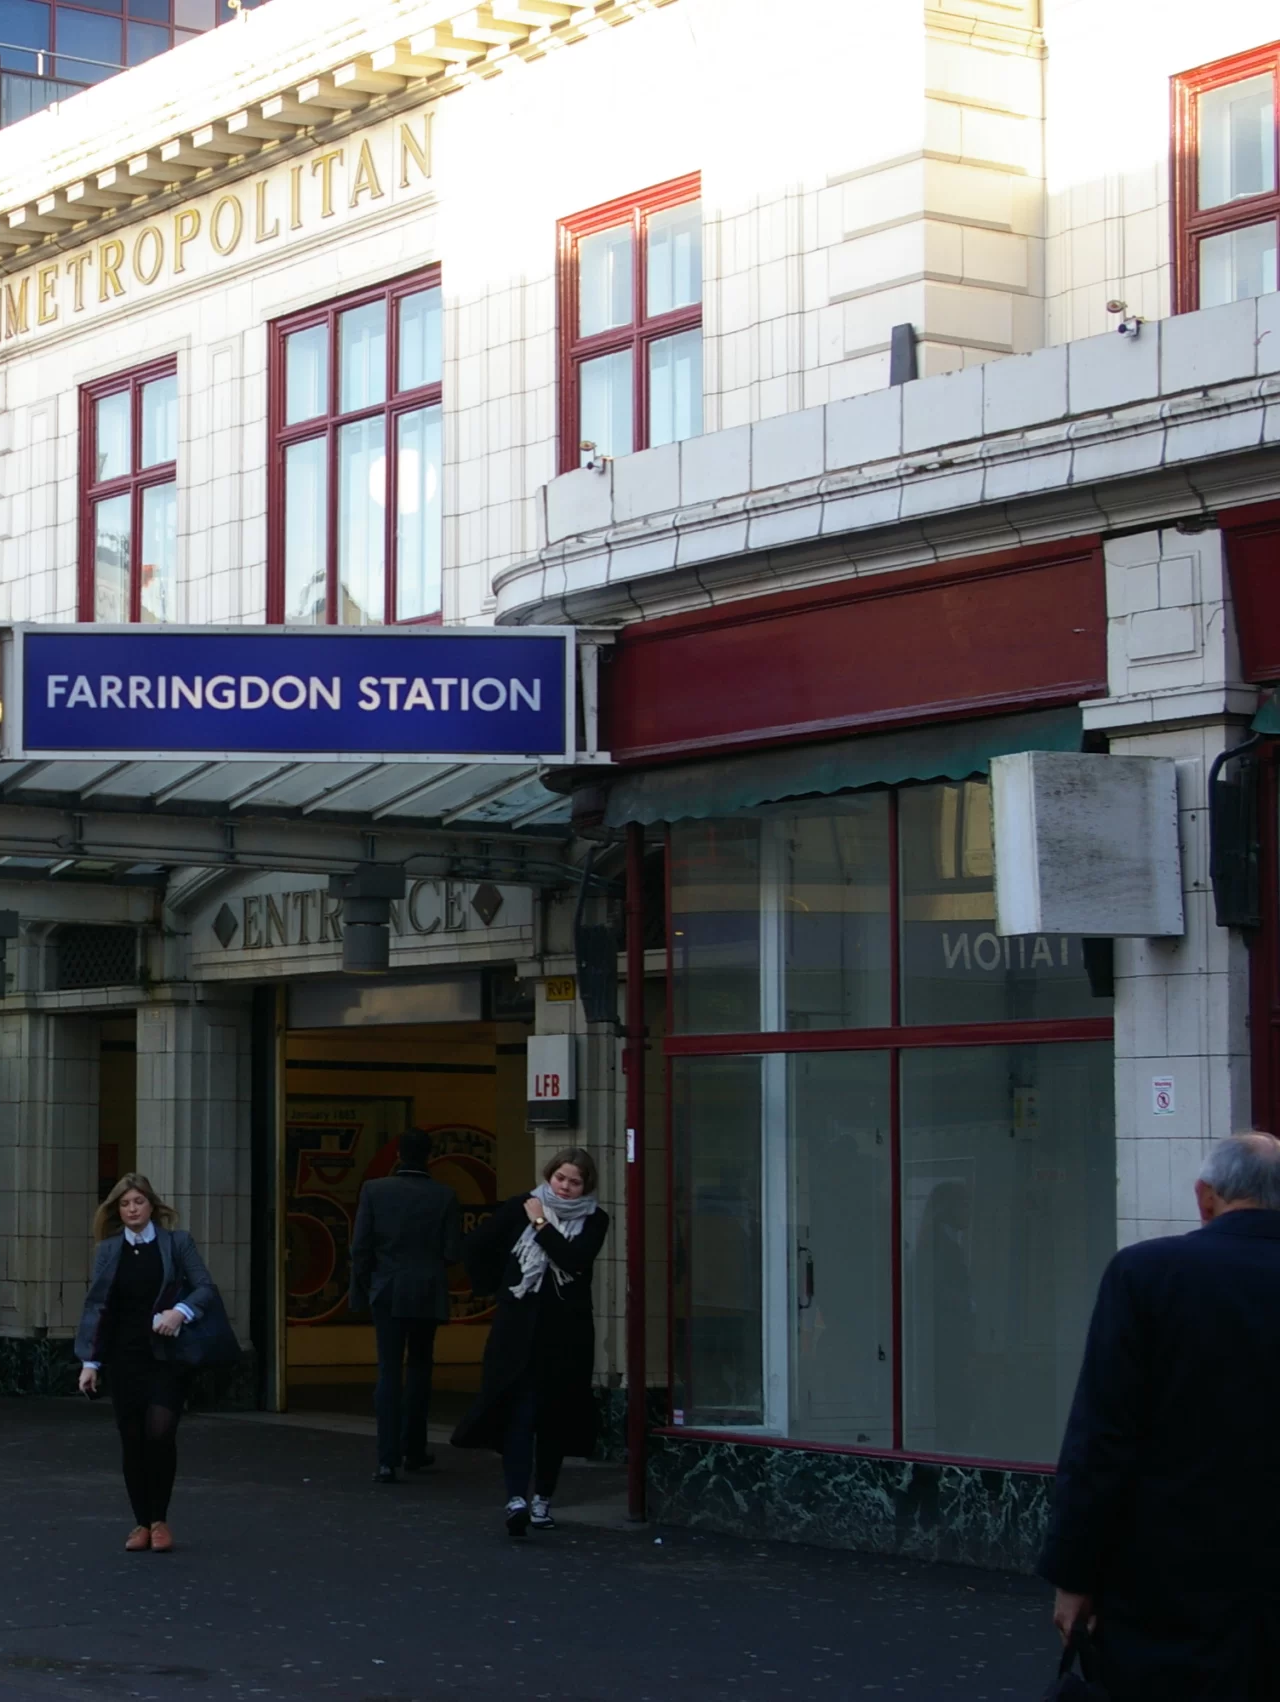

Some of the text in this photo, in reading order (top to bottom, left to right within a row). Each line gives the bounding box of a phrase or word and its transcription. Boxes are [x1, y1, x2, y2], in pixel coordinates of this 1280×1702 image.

[4, 111, 436, 340] METROPOLITAN
[46, 674, 542, 712] FARRINGDON STATION
[242, 878, 467, 950] ENTRNCE
[535, 1074, 560, 1097] LFB
